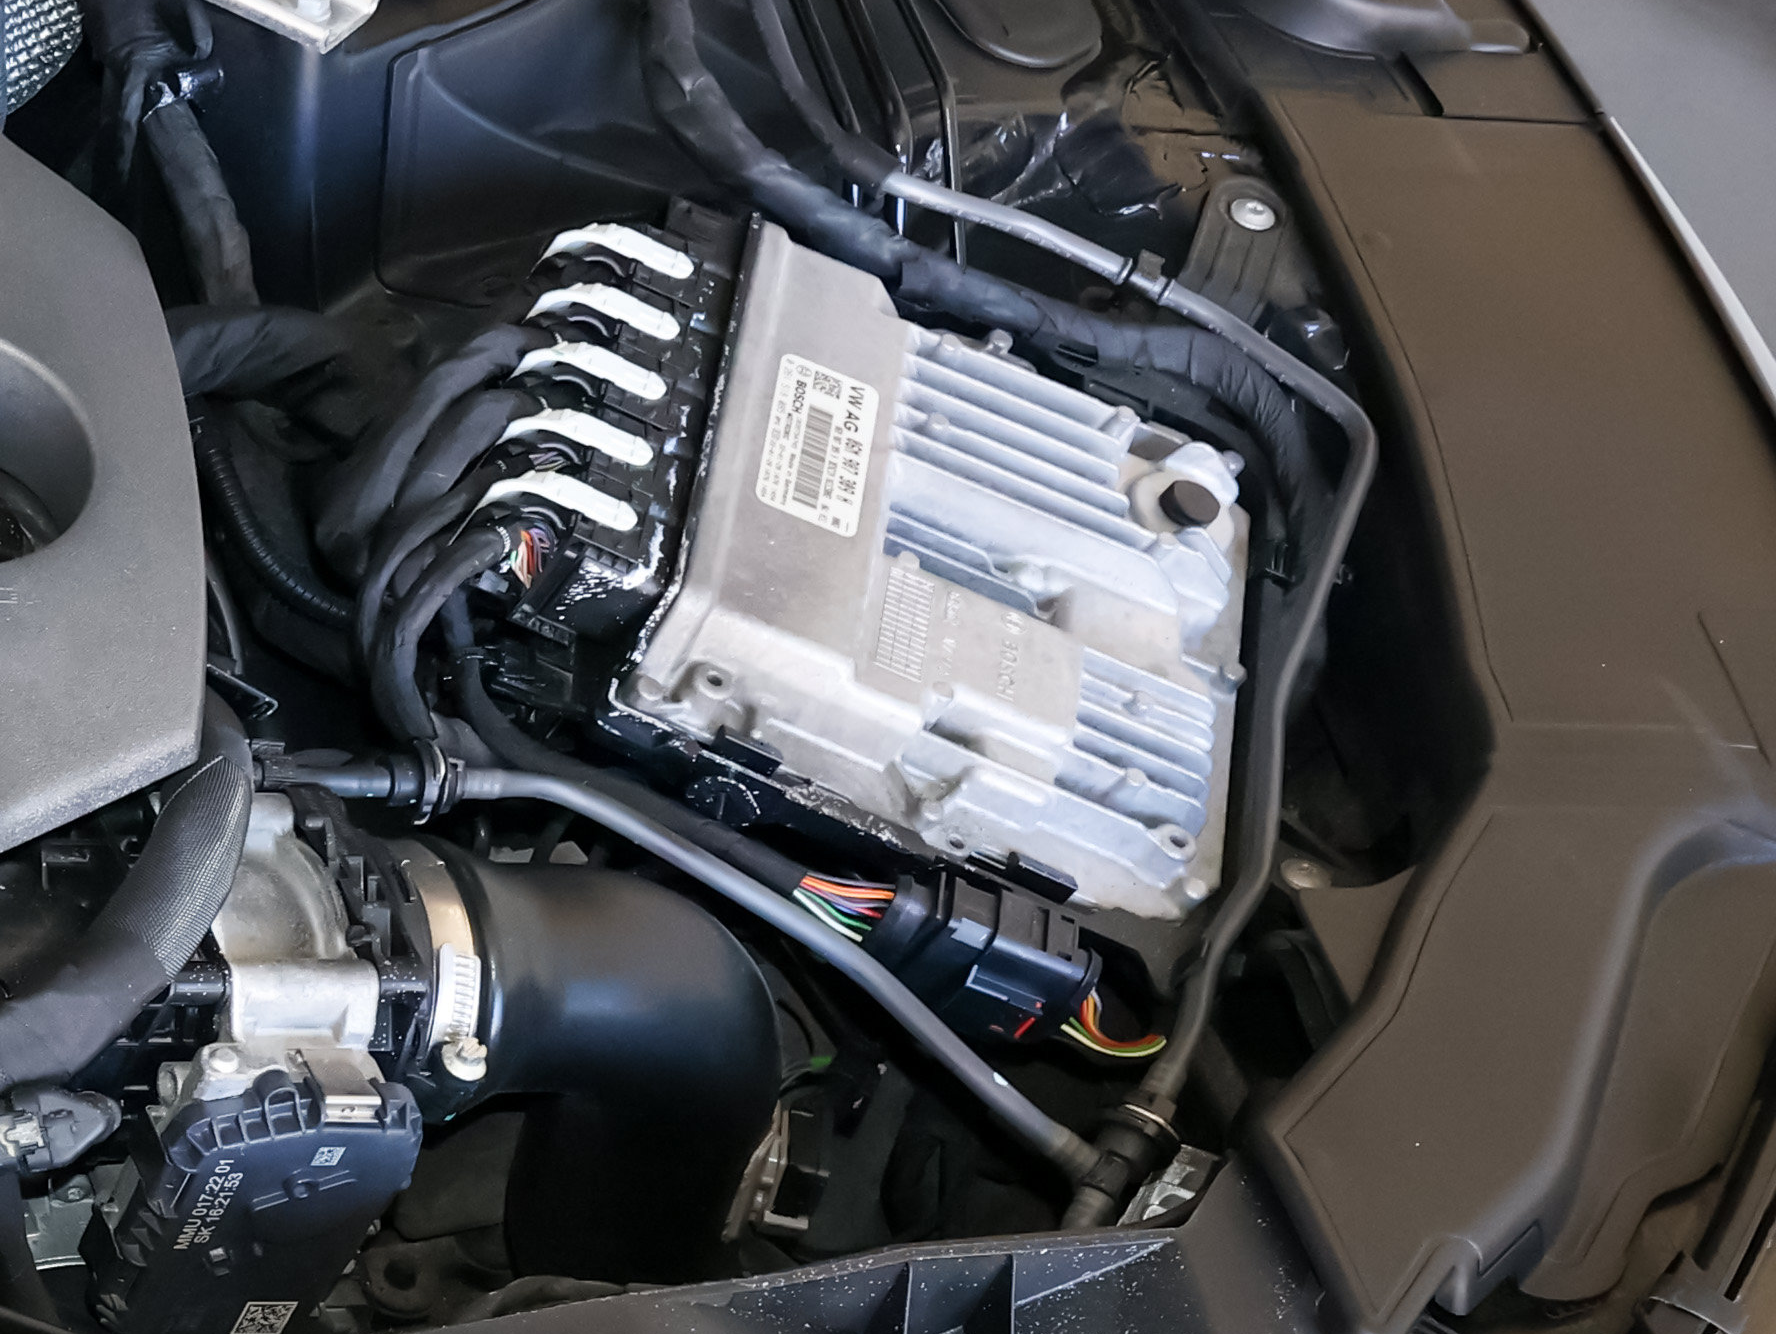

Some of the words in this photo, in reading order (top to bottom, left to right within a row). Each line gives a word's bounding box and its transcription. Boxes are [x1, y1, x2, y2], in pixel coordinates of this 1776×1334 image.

[792, 380, 807, 414] BOSCH
[847, 385, 865, 410] VW
[843, 409, 860, 433] AG
[173, 1219, 201, 1249] MMU
[215, 1160, 234, 1173] 01
[194, 1225, 216, 1243] SK
